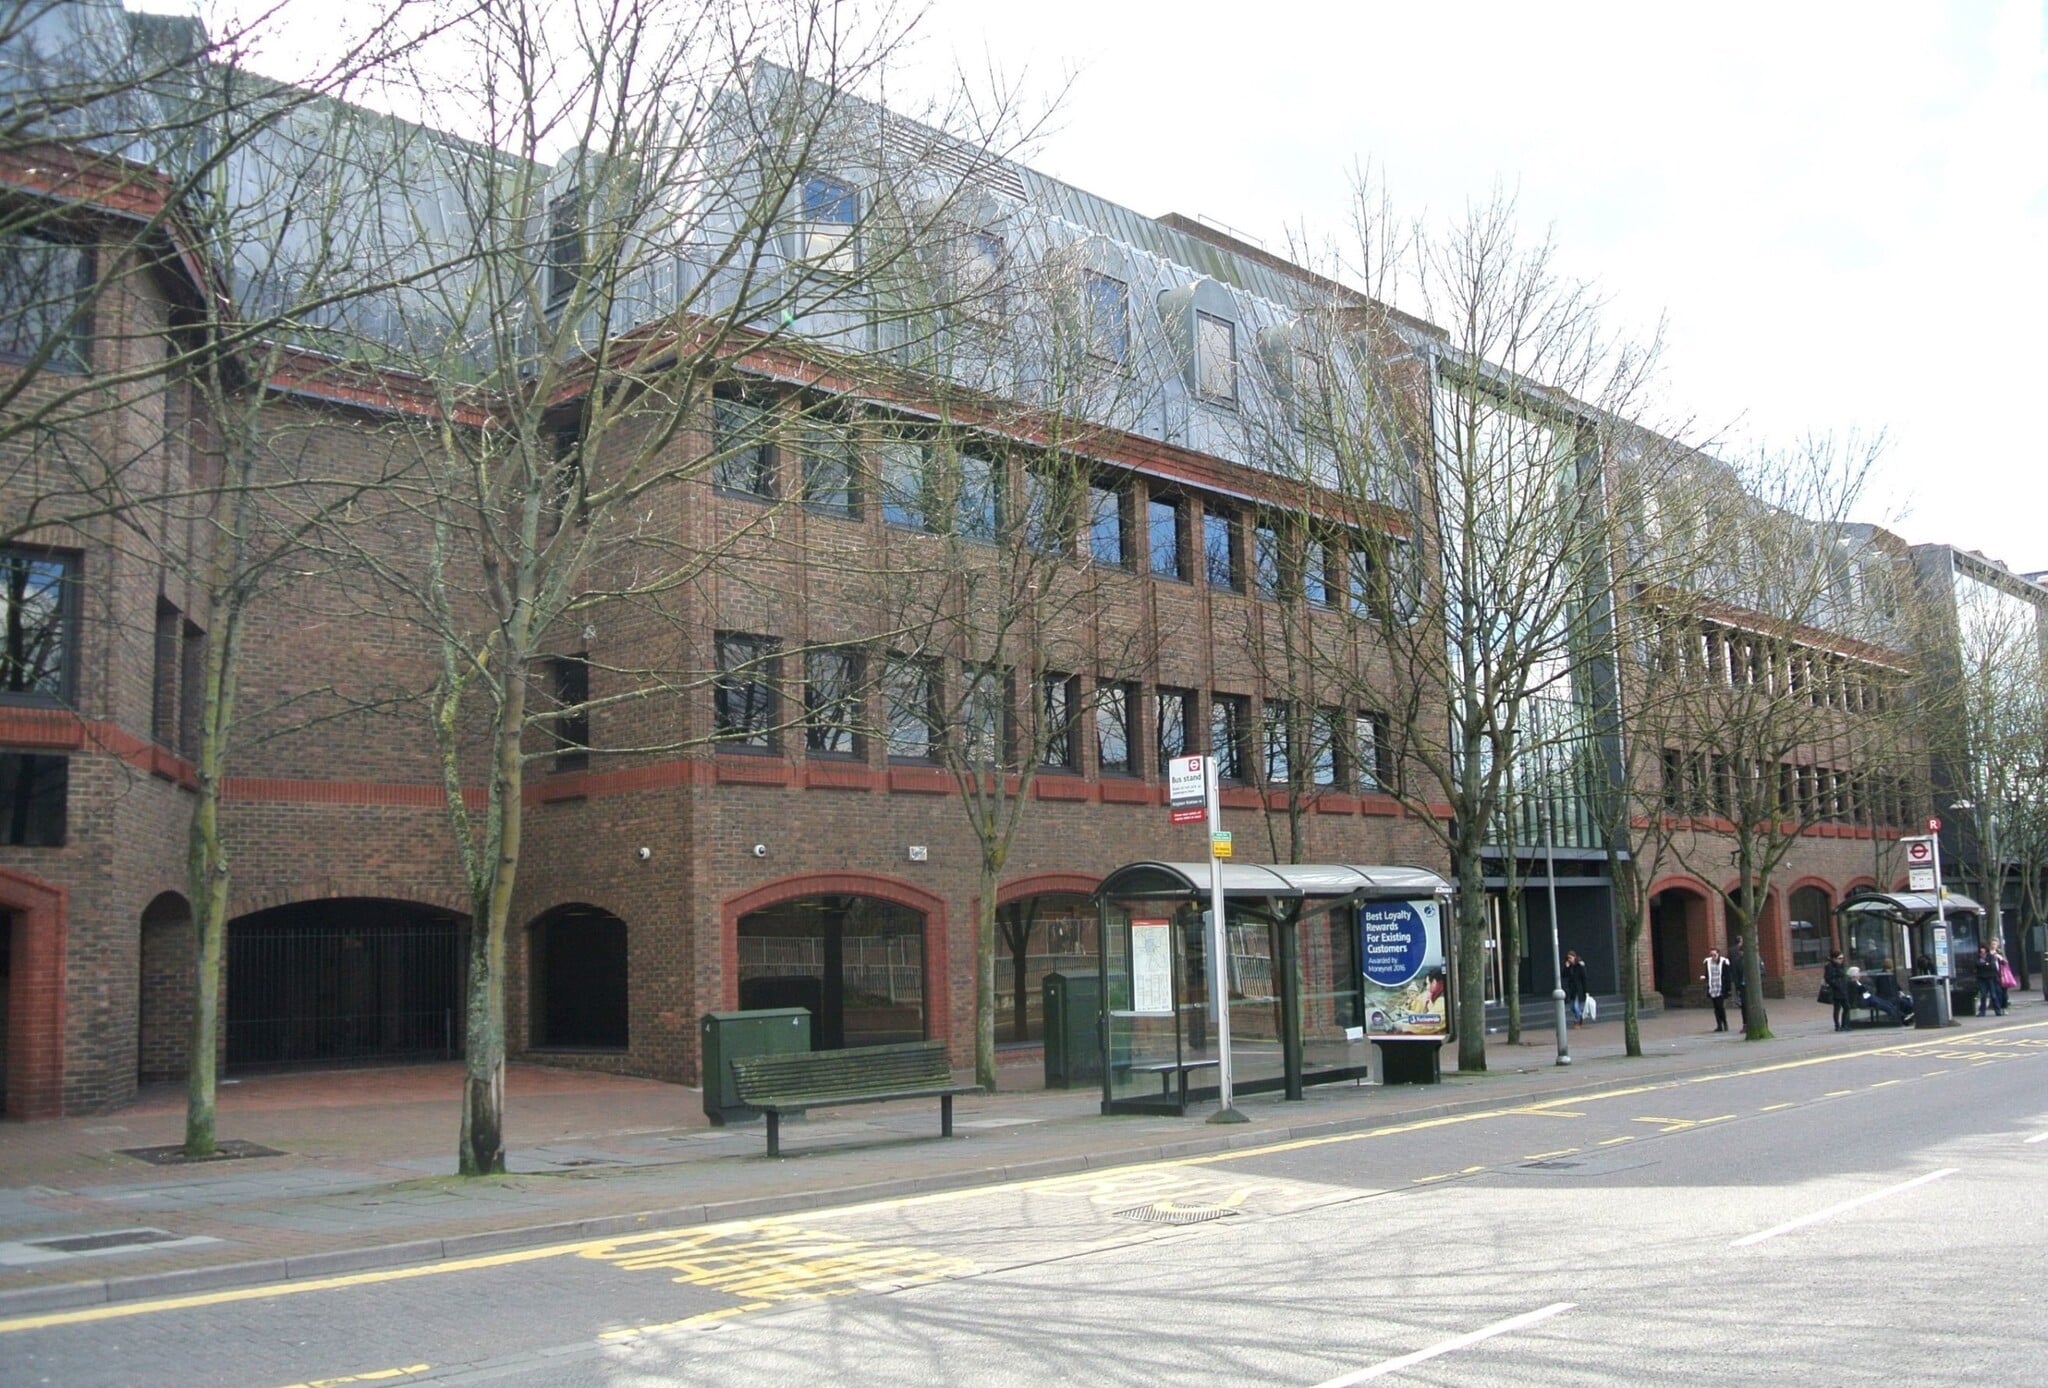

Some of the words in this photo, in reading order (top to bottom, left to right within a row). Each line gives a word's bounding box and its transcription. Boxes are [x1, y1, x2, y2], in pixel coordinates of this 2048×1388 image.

[1171, 776, 1182, 784] Bus
[1183, 774, 1202, 783] stand
[1929, 819, 1938, 830] R
[1365, 911, 1383, 921] Best
[1384, 910, 1412, 922] Loyalty
[1366, 922, 1399, 932] Rewards
[1367, 933, 1380, 943] For
[1381, 932, 1412, 944] Existing
[1367, 944, 1408, 954] Customers
[1391, 957, 1398, 965] by
[1393, 964, 1406, 972] 2016
[792, 1016, 799, 1025] 4
